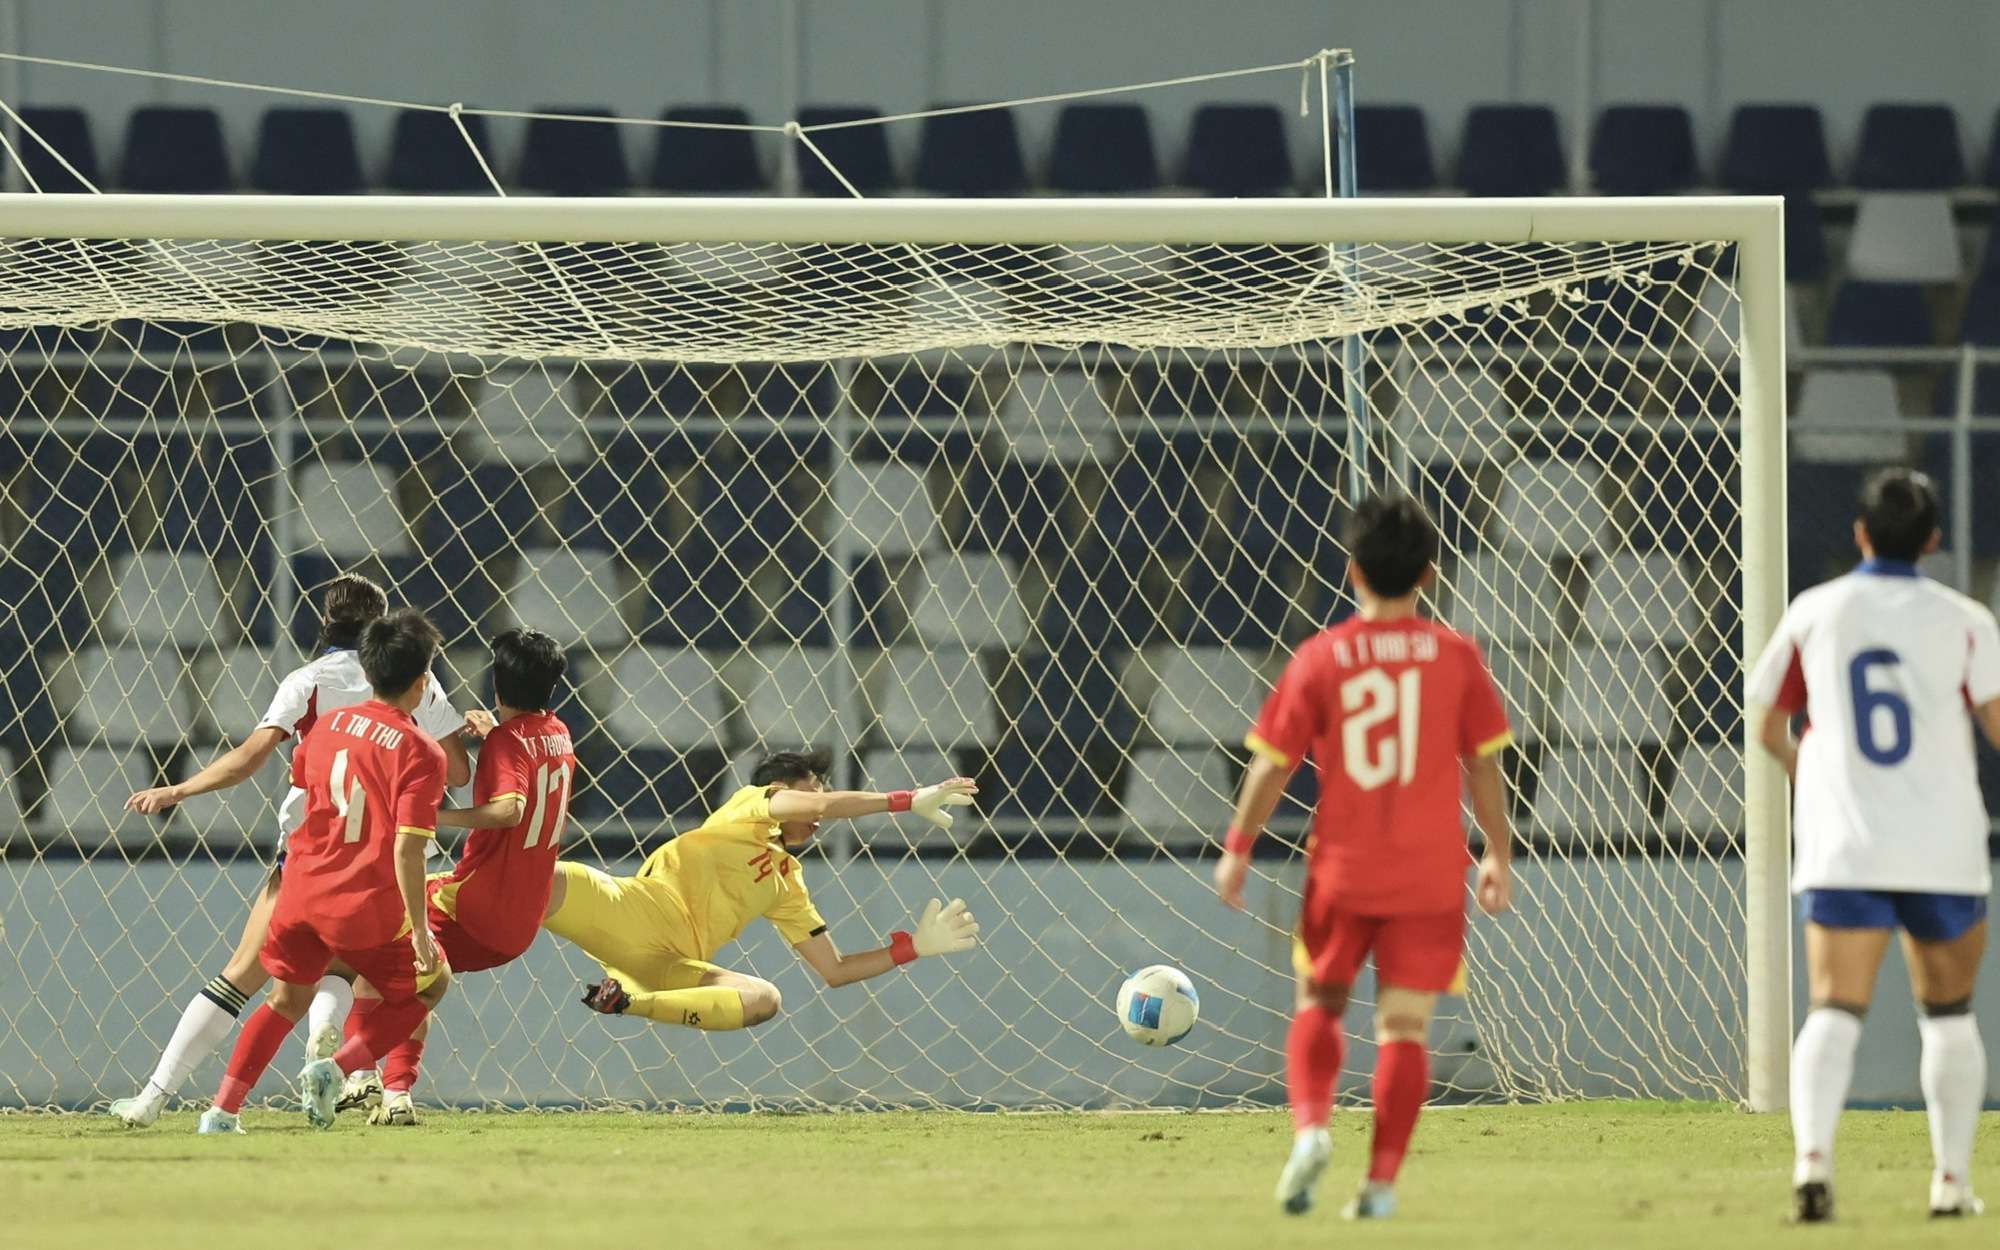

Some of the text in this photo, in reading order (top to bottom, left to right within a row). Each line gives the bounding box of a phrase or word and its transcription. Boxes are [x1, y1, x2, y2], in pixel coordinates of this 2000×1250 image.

[346, 714, 372, 738] THI
[369, 721, 404, 750] THU
[1340, 667, 1421, 791] 21
[1849, 648, 1912, 766] 6
[330, 748, 366, 844] 4
[523, 761, 570, 850] 17
